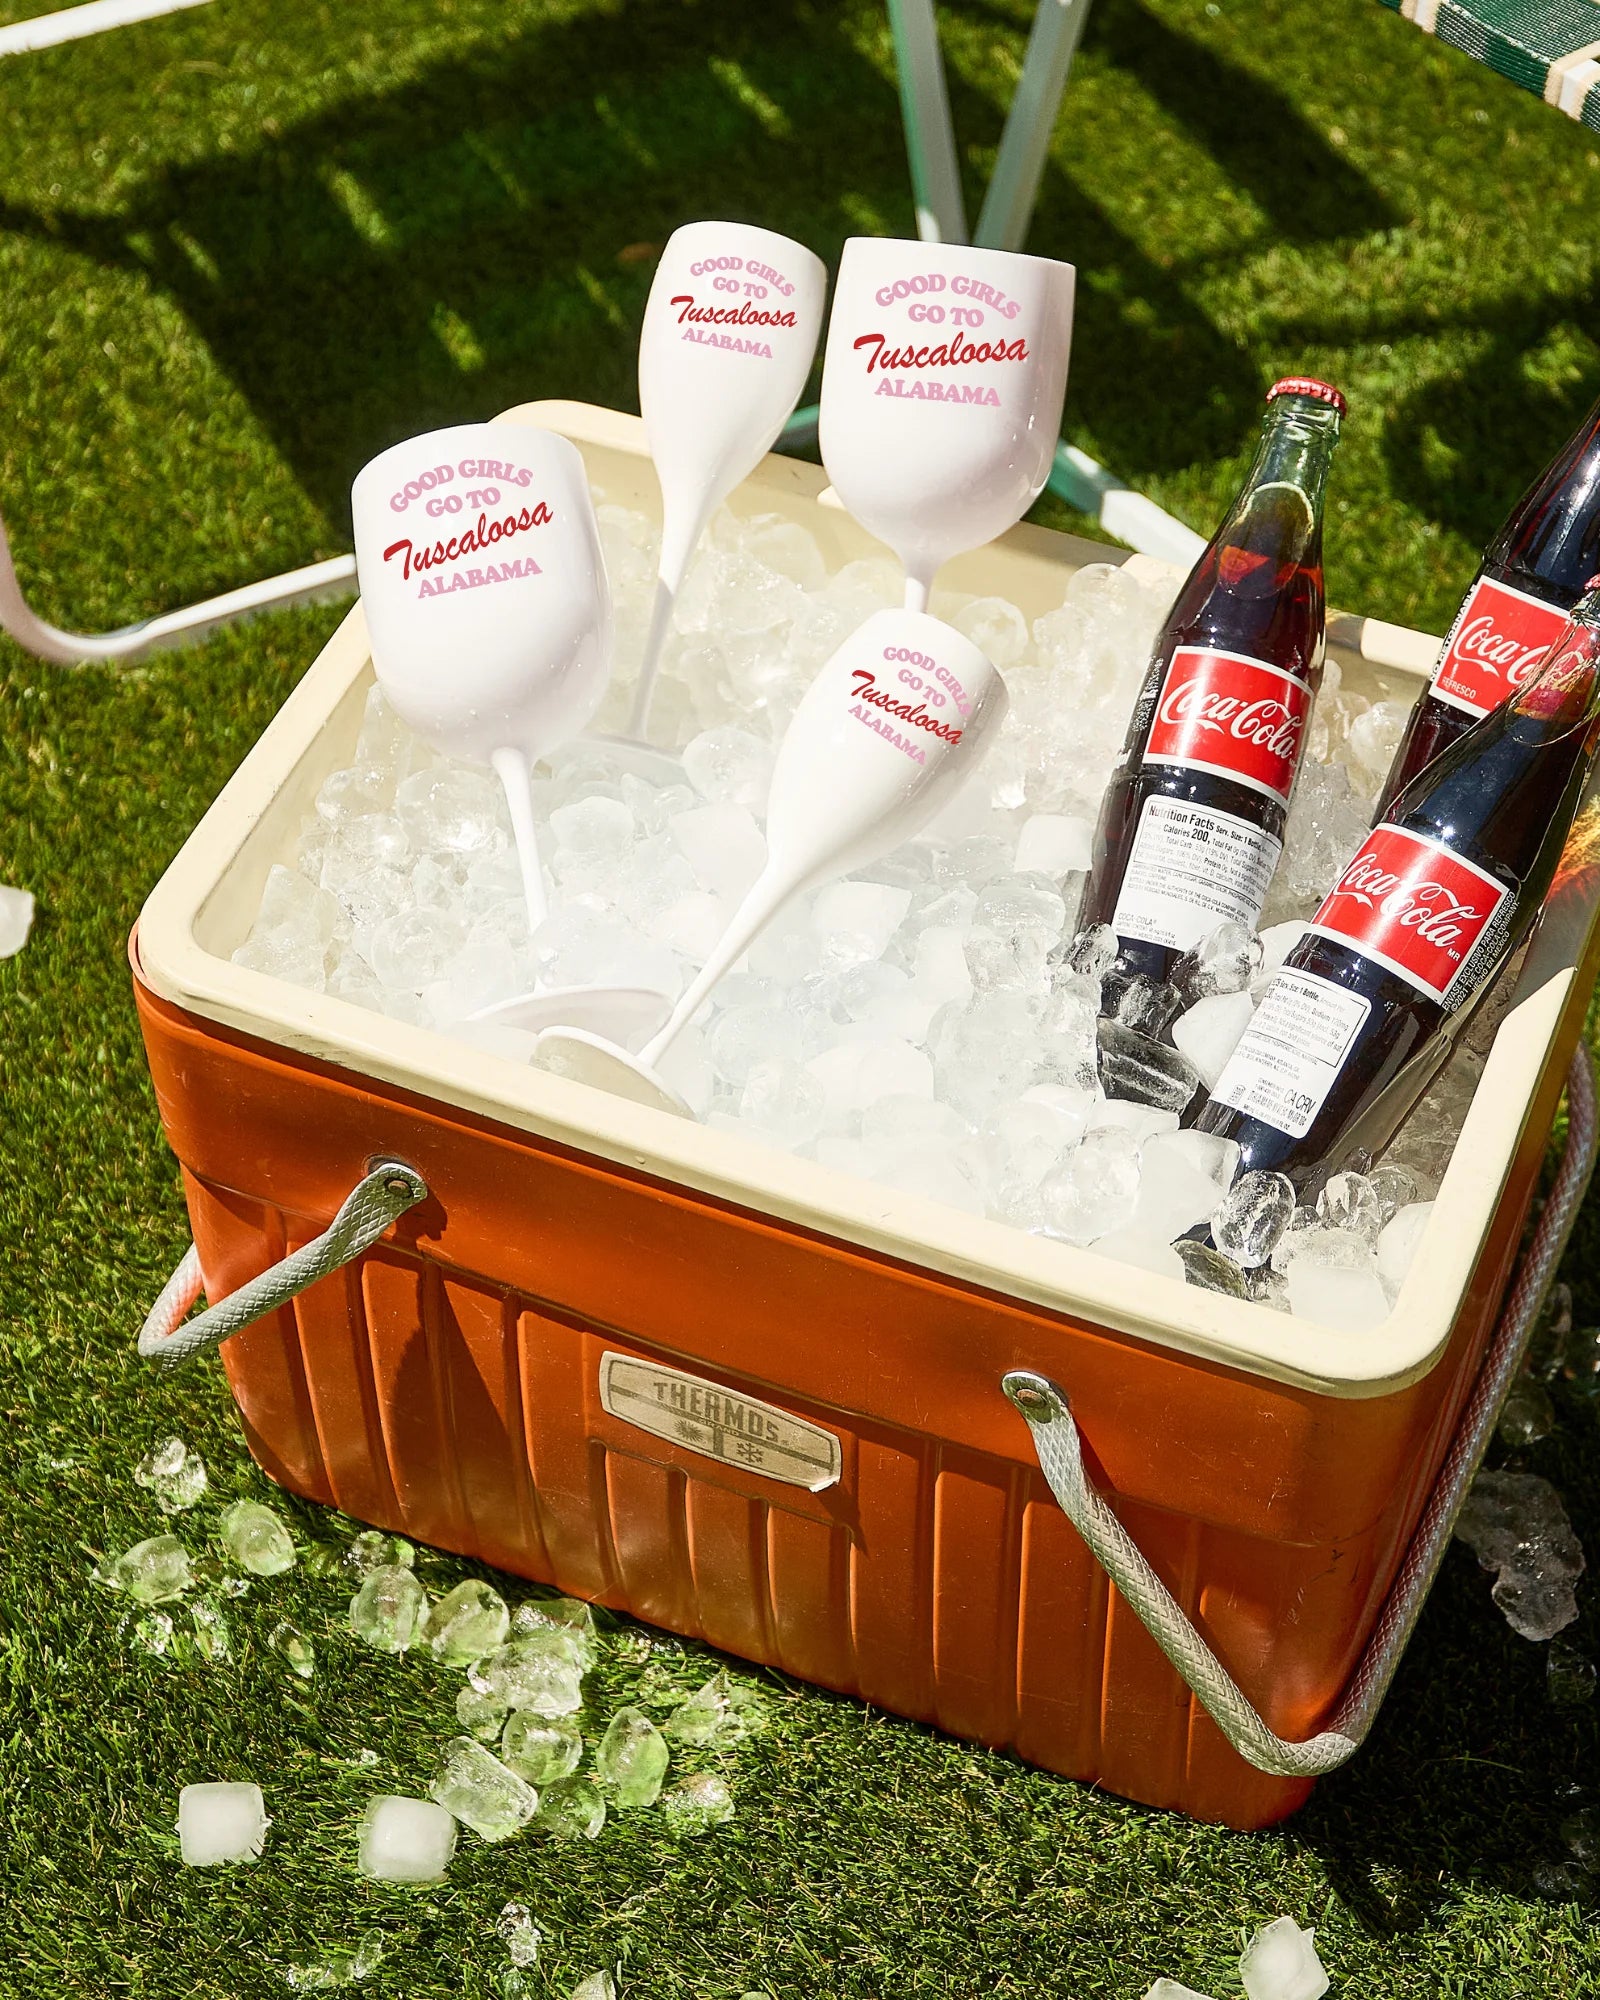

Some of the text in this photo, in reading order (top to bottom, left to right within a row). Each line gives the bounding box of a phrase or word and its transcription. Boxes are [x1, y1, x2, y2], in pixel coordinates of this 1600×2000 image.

[690, 257, 795, 296] GOOD GIRLS
[713, 277, 768, 299] GO TO
[671, 296, 797, 327] Tuscaloosa
[876, 274, 1021, 319] GOOD GIRLS
[908, 304, 985, 327] GO TO
[682, 328, 772, 358] ALABAMA
[854, 332, 1029, 373] Tuscaloosa
[875, 378, 1002, 406] ALABAMA
[390, 460, 533, 512] GOOD GIRLS
[426, 488, 501, 517] GO TO
[384, 501, 553, 580] Tuscaloosa
[418, 557, 542, 598] ALABAMA
[883, 647, 972, 716] GOOD GIRLS
[898, 669, 946, 707] GO TO
[1441, 676, 1477, 699] REFRESCO
[851, 669, 963, 745] Tuscaloosa
[1160, 677, 1303, 759] Coca-Cola
[848, 704, 926, 765] ALABAMA
[1149, 805, 1188, 823] Nutrition
[1189, 814, 1215, 831] Facts
[1216, 825, 1229, 836] Serv.
[1163, 824, 1190, 838] Calories
[1191, 828, 1210, 845] 200,
[1212, 838, 1225, 848] Total
[1225, 843, 1233, 851] Fat
[1167, 836, 1179, 845] Total
[1204, 857, 1221, 869] Protein
[1333, 853, 1483, 948] Coca-Cola
[1441, 891, 1516, 1011] ENVASE EXCLUSIVO PARA REFRESCO
[1446, 947, 1461, 961] MR
[1466, 971, 1478, 989] THE
[1474, 934, 1501, 973] COCA-COLA
[1471, 969, 1489, 992] HECHO
[1486, 959, 1495, 970] EN
[1311, 1007, 1330, 1021] Sodium
[1284, 1088, 1297, 1106] CA
[1295, 1094, 1316, 1114] CRV
[653, 1382, 780, 1442] THERMOS
